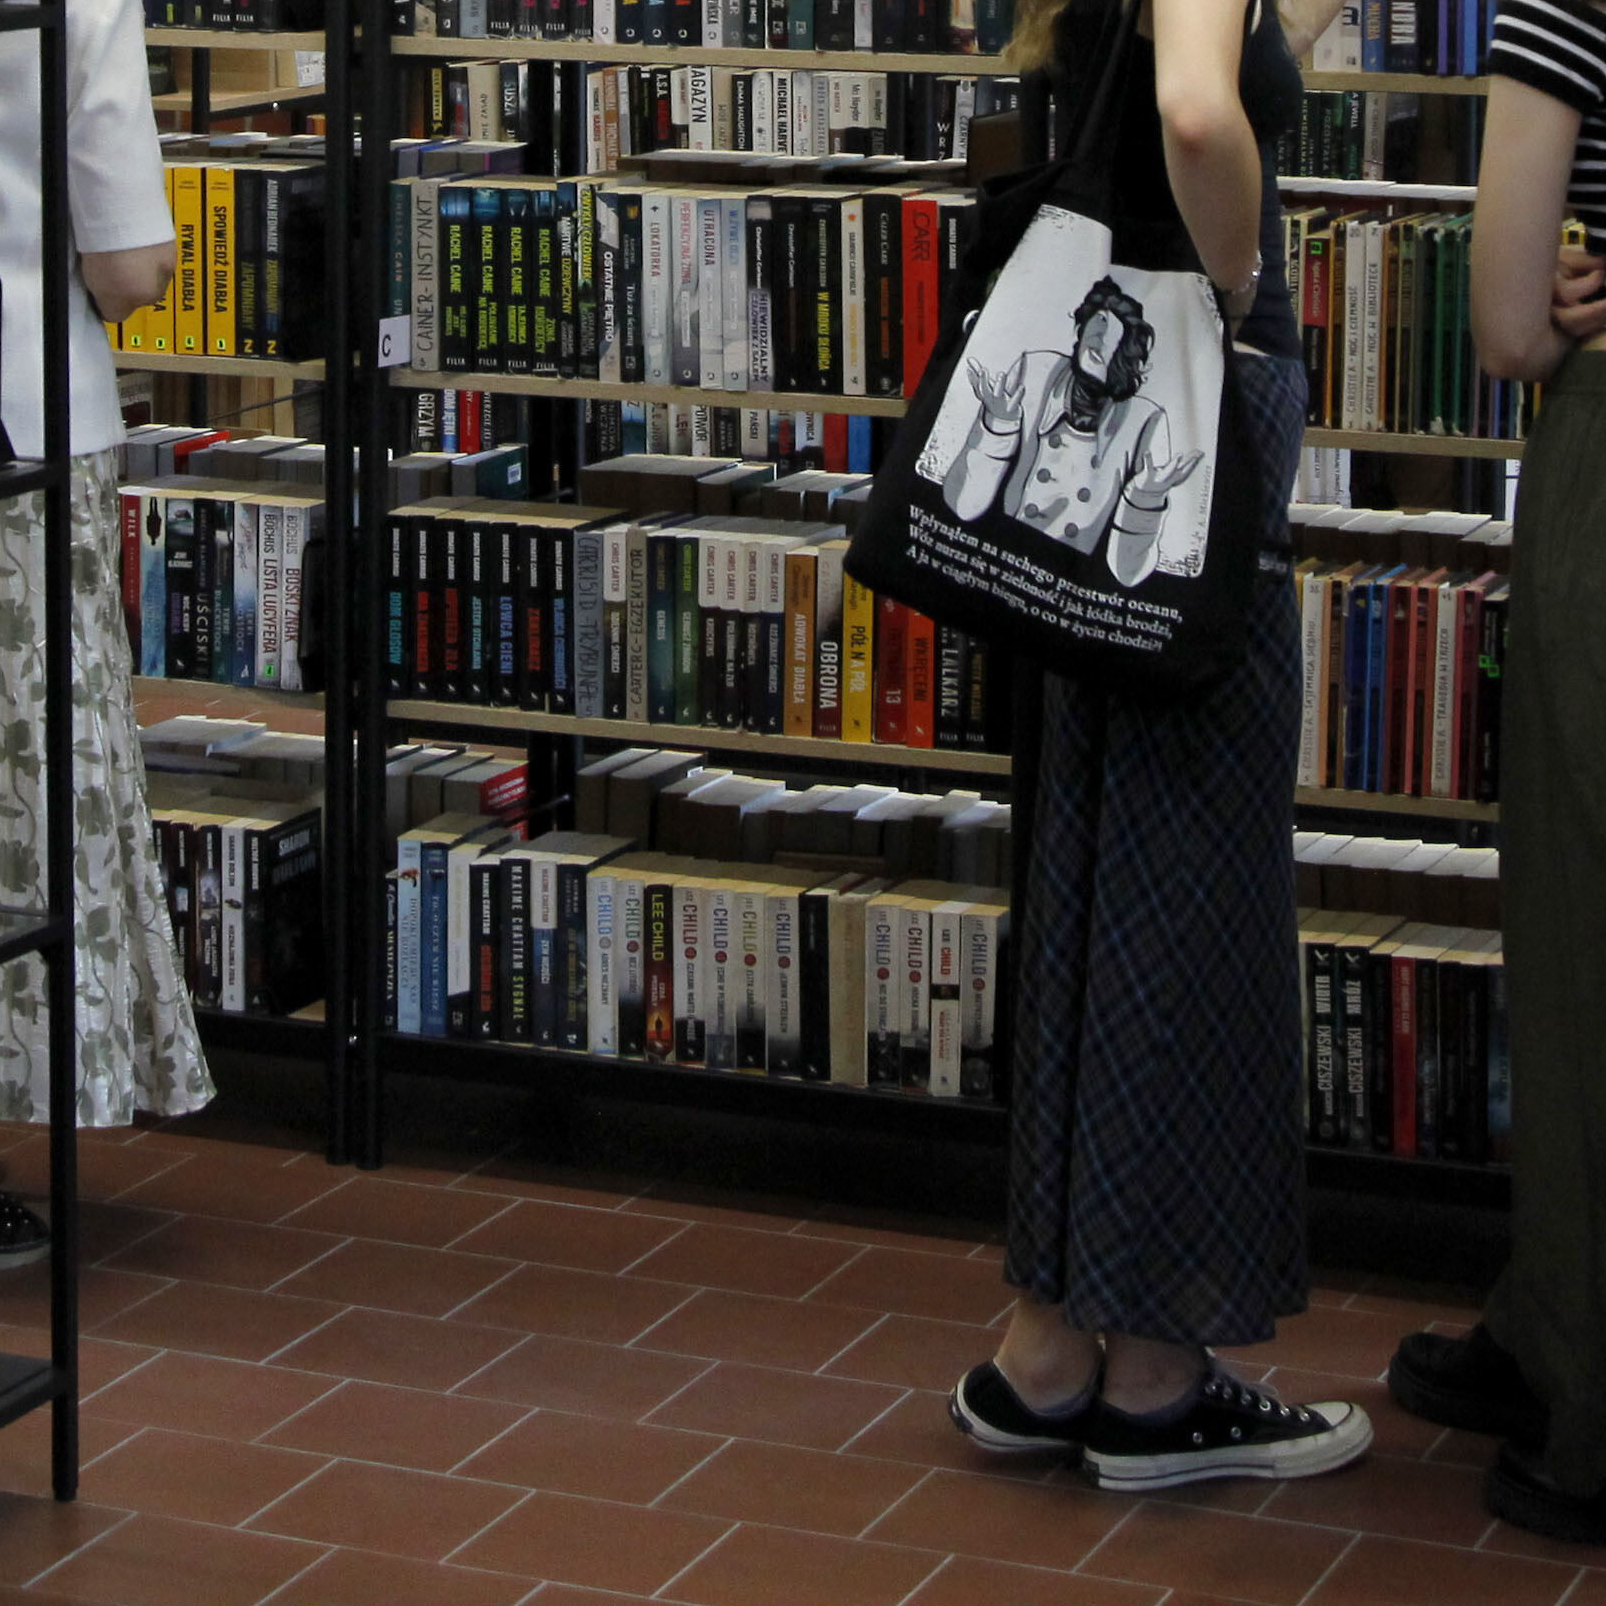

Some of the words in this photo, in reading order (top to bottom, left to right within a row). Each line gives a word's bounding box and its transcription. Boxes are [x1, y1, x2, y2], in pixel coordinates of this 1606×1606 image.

[657, 74, 667, 97] A.S.A.
[736, 81, 744, 104] EMMA
[777, 78, 787, 119] MICHAEL
[737, 106, 745, 149] HAUGHTON
[182, 224, 194, 265] RYWAL
[214, 206, 229, 266] SPOWIEDŹ
[450, 225, 461, 261] RACHEL
[481, 225, 492, 261] RACHEL
[511, 227, 522, 263] RACHEL
[538, 229, 550, 265] RACHEL
[650, 222, 660, 277] LOKATORKA
[704, 210, 715, 265] UTRACONA
[182, 269, 194, 312] DIABŁA
[214, 270, 227, 313] DIABŁA
[450, 265, 460, 293] CAINE
[481, 266, 492, 293] CAINE
[512, 267, 522, 295] CAINE
[539, 269, 550, 297] CAINE
[382, 334, 392, 358] C
[127, 509, 136, 537] WILK
[264, 514, 274, 553] BOCHUS
[287, 515, 297, 554] BOCHUS
[263, 558, 277, 590] LISTA
[909, 504, 979, 548] Wpłynąłem
[982, 541, 998, 556] na
[1000, 551, 1054, 584] suchego
[1056, 578, 1125, 607] przestwór
[1127, 599, 1183, 623] oceanu,
[909, 524, 934, 547] Wóz
[935, 541, 968, 563] nurza
[970, 556, 987, 574] się
[989, 565, 1000, 575] w
[1001, 571, 1059, 604] zieloność
[1058, 595, 1065, 608] i
[1064, 599, 1085, 616] jak
[1086, 606, 1123, 625] łódka
[1126, 615, 1172, 640] brodzi,
[285, 568, 300, 605] BOSKI
[906, 545, 917, 558] A
[916, 552, 929, 564] ja
[931, 558, 941, 569] w
[942, 564, 989, 591] ciągłym
[991, 582, 1028, 614] biegu,
[1030, 606, 1040, 616] o
[1041, 610, 1057, 624] co
[1059, 618, 1071, 628] w
[1072, 622, 1105, 638] życiu
[263, 594, 277, 653] LUCYFERA
[285, 609, 300, 642] ZNAK
[794, 614, 805, 661] ADWOKAT
[794, 666, 805, 703] DIABŁA
[819, 642, 838, 709] OBRONA
[941, 648, 959, 717] LALKARZ
[886, 689, 901, 704] 13
[512, 866, 522, 910] MAXIME
[652, 894, 664, 917] LEE
[598, 895, 612, 935] CHILD
[626, 898, 640, 938] CHILD
[683, 904, 698, 944] CHILD
[713, 908, 727, 948] CHILD
[743, 911, 757, 952] CHILD
[776, 913, 791, 954] CHILD
[512, 917, 523, 969] CHATTAM
[652, 922, 664, 961] CHILD
[876, 925, 890, 965] CHILD
[908, 927, 922, 968] CHILD
[942, 930, 950, 942] LEE
[973, 934, 987, 974] CHILD
[941, 947, 951, 975] CHILD
[1317, 1025, 1332, 1090] CISZEWSKI
[1348, 1028, 1363, 1093] CISZEWSKI
